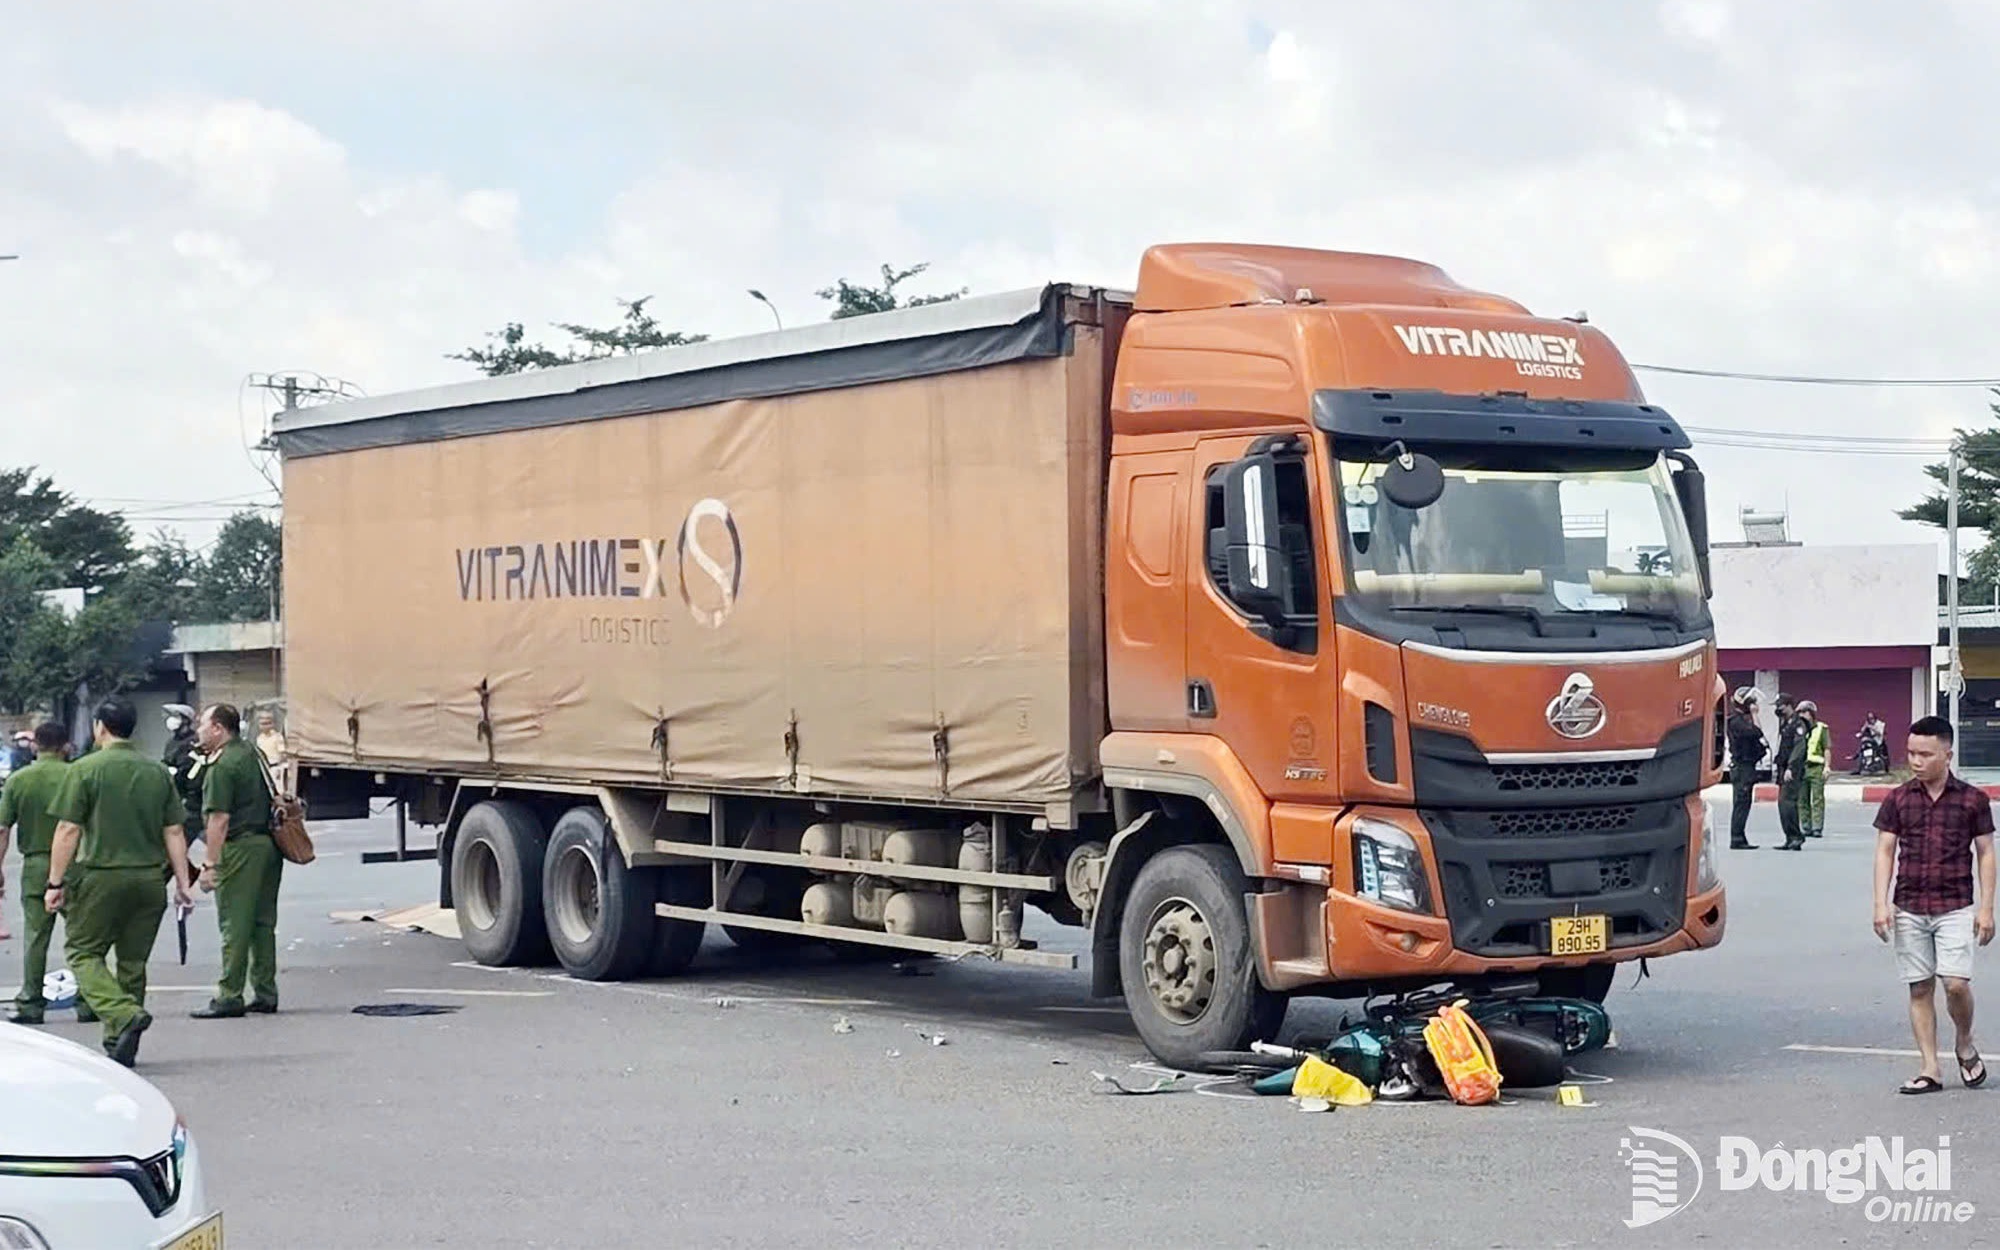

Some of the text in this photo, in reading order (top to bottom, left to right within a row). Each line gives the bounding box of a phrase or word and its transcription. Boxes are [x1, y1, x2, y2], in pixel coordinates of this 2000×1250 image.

[1393, 325, 1585, 366] VITRANIMEX
[1516, 362, 1582, 379] LOGISTICS
[455, 538, 667, 602] VITRANIMEX
[1567, 918, 1591, 935] 29H
[1557, 935, 1600, 953] 890.95
